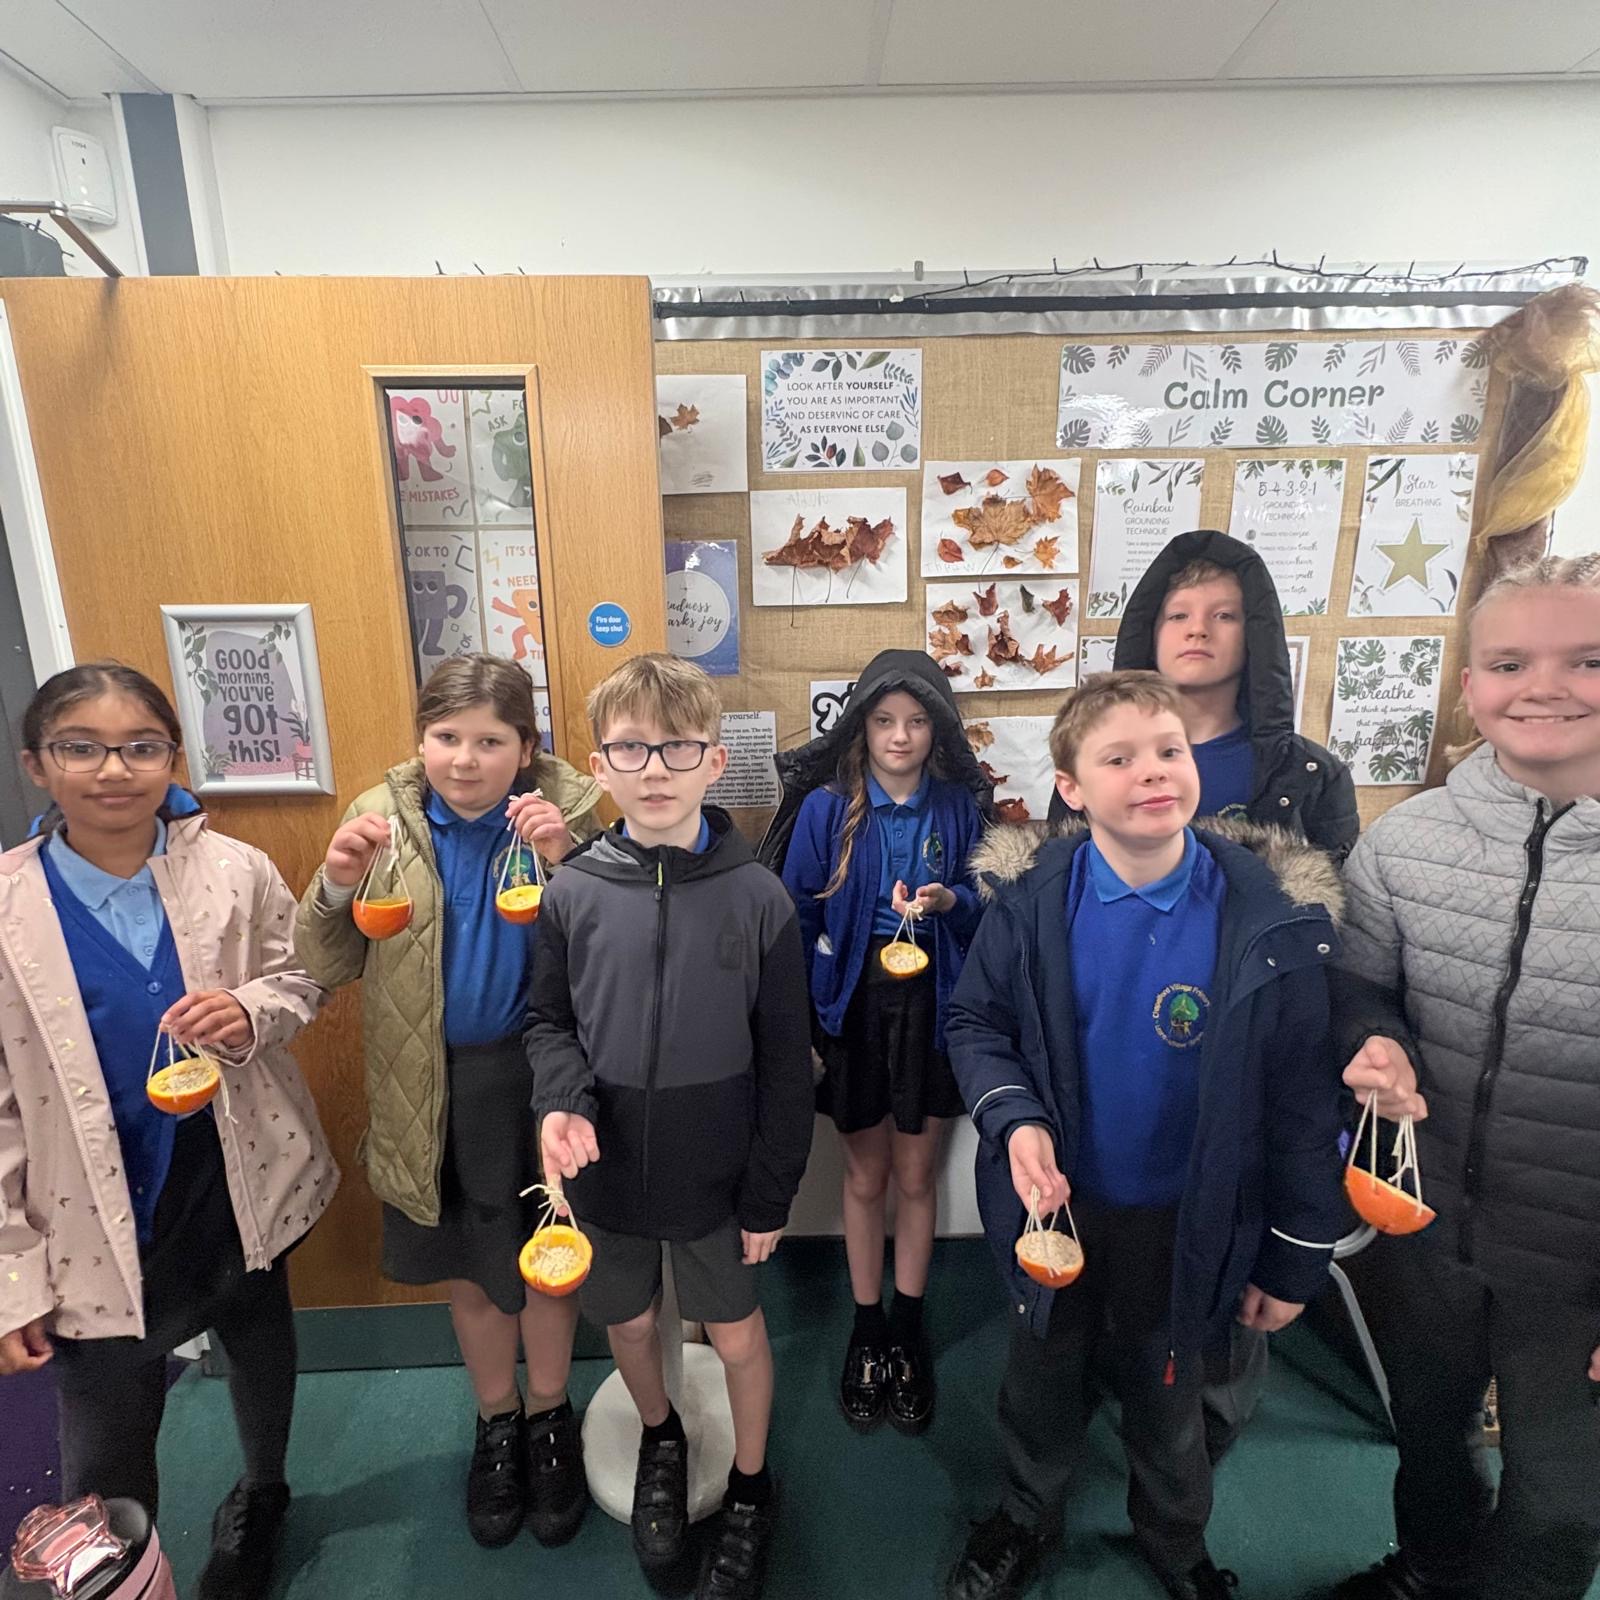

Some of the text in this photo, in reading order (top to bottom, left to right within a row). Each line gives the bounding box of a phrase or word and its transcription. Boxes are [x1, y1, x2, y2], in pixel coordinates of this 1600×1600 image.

[787, 381, 895, 391] LOOK AFTER YOURSELF
[1164, 377, 1385, 410] Calm Corner
[787, 395, 900, 405] YOU ARE AS IMPORTANT
[784, 410, 901, 420] AND DESERVING OF CARE
[487, 415, 509, 432] ASK
[800, 424, 886, 434] AS EVERYONE ELSE
[1403, 473, 1438, 494] Star
[408, 487, 460, 503] MISTAKES
[1123, 497, 1175, 514] Rainbow
[1395, 498, 1442, 508] BREATHING
[1125, 517, 1170, 526] GROUNDING
[1126, 528, 1168, 536] TECHNIQUE
[415, 546, 431, 557] OK
[432, 546, 449, 557] TO
[505, 546, 526, 557] IT'S
[668, 611, 722, 632] arks joy
[1357, 683, 1416, 700] breathe
